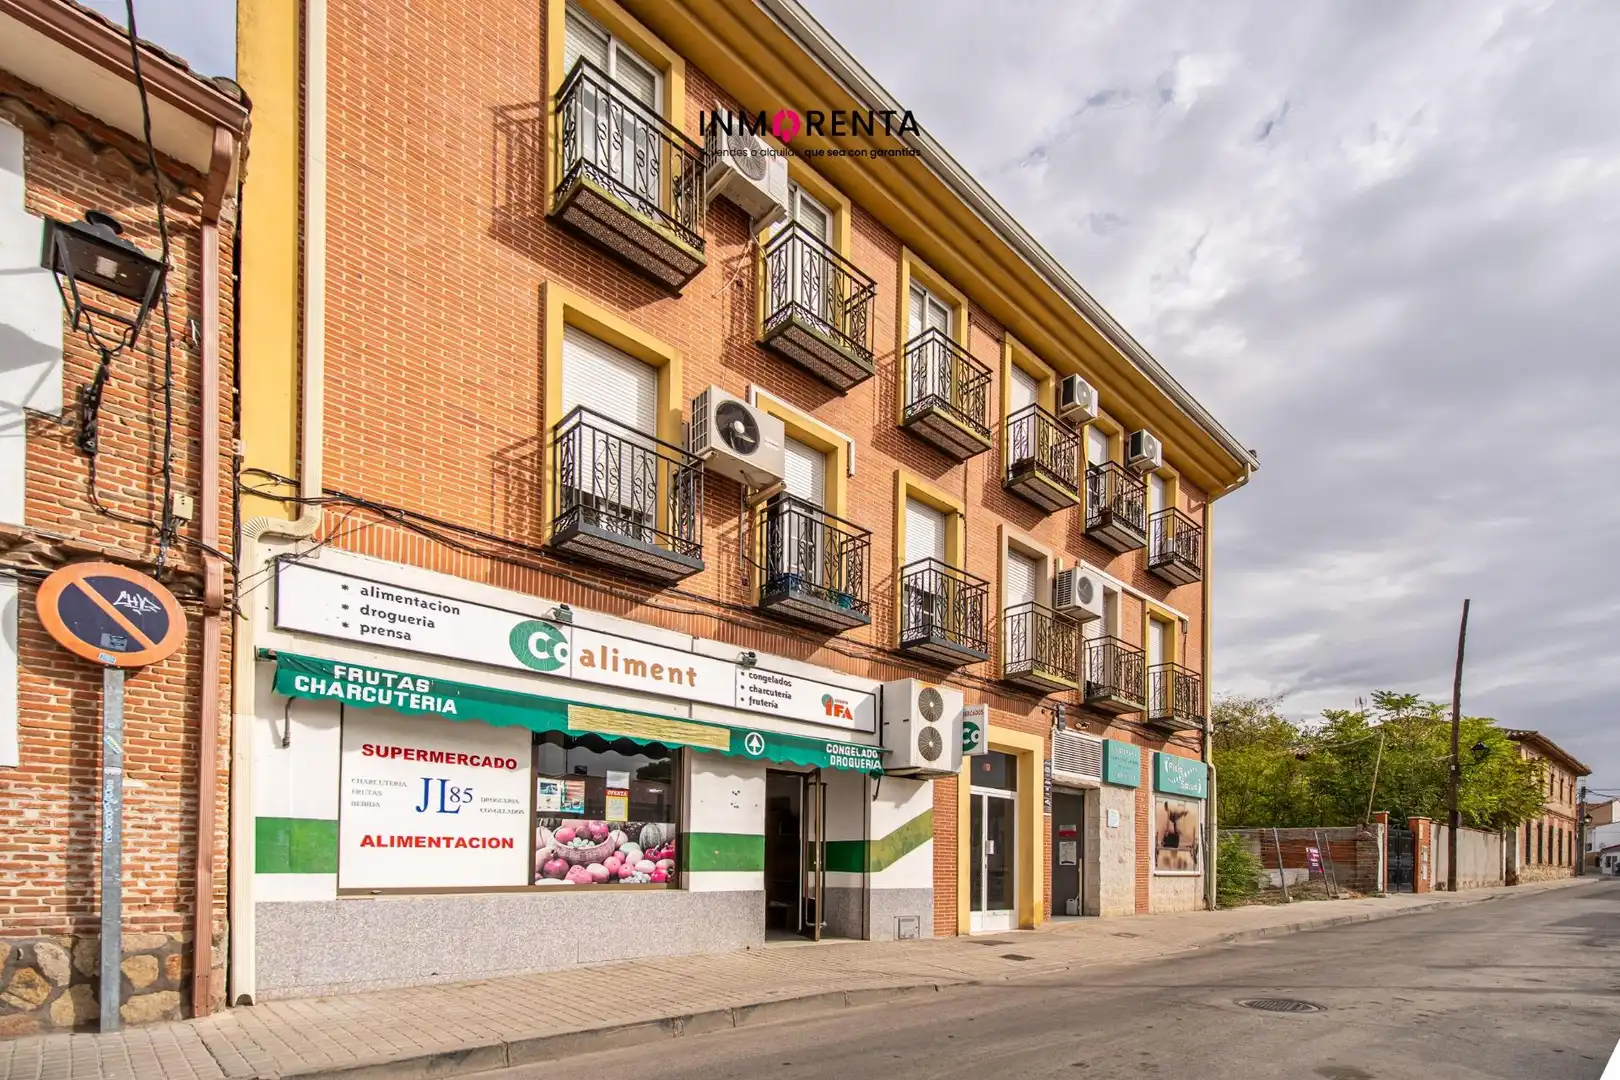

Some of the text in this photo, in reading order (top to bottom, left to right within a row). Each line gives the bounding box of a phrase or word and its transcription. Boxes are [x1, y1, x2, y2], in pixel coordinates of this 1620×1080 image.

[360, 585, 461, 616] alimentacion
[359, 604, 436, 629] drogueria
[360, 623, 412, 641] prensa
[579, 644, 697, 687] aliment
[333, 664, 431, 693] FRUTAS
[748, 672, 792, 687] congelados
[294, 675, 457, 715] CHARCUTERIA
[362, 743, 517, 770] SUPERMERCADO
[829, 755, 882, 770] DROGUERIA
[351, 778, 408, 788] CHARCUTERIA
[351, 789, 383, 797] FRUTAS
[359, 834, 514, 849] ALIMENTACION
